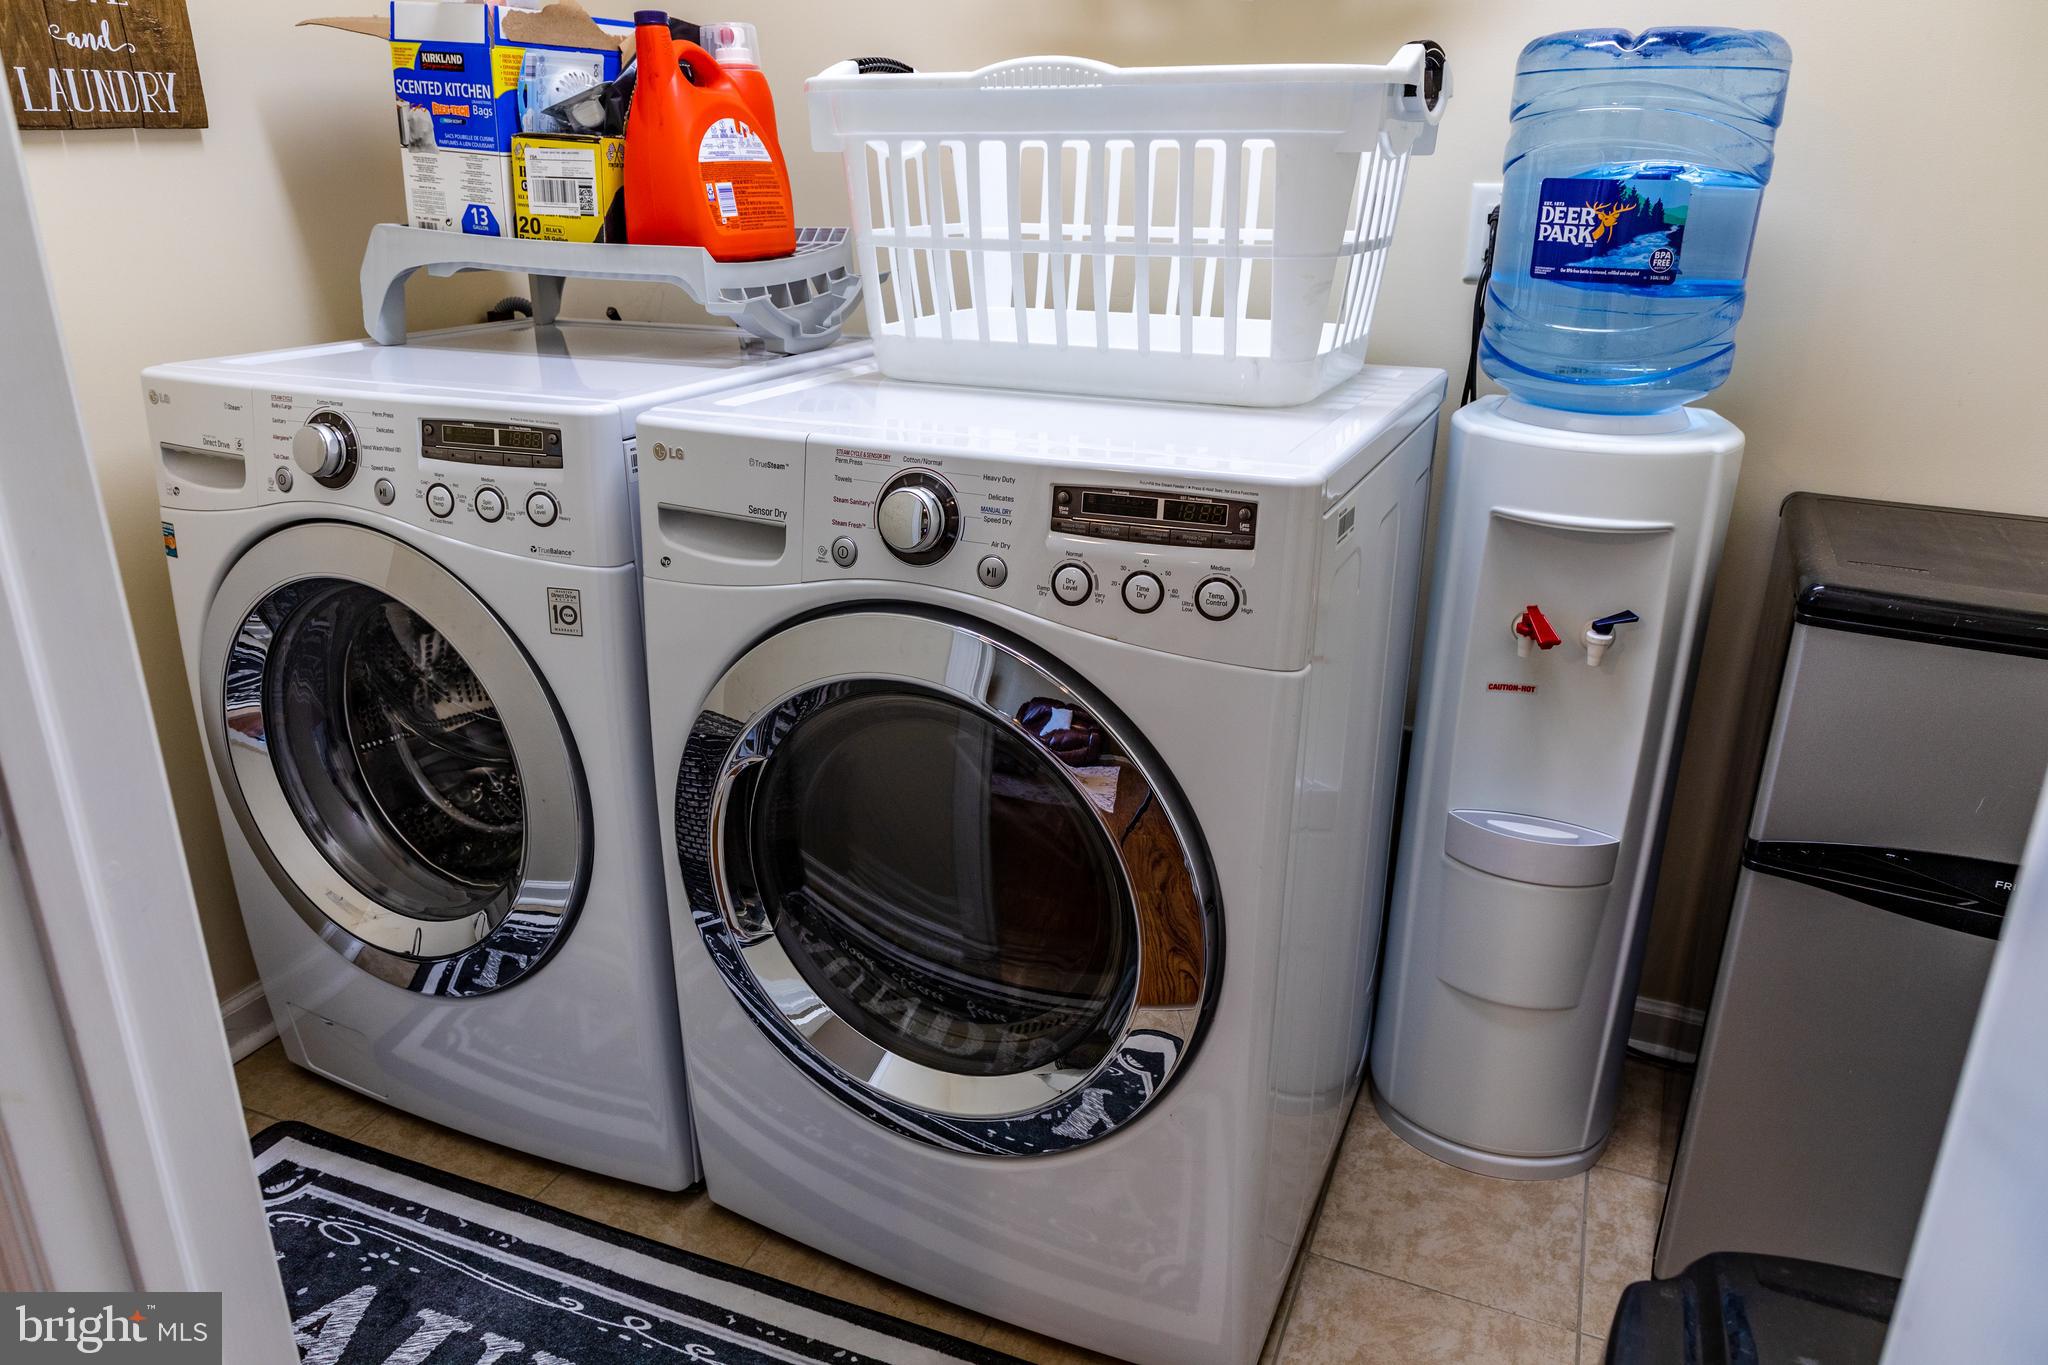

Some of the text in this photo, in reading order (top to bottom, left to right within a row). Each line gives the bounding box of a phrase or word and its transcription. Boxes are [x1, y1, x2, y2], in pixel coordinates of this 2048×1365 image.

[421, 52, 463, 69] KIRKLAND
[13, 66, 179, 114] LAUNDRY
[395, 78, 491, 99] SCENTED KITCHEN
[472, 105, 493, 118] Bags
[471, 207, 489, 226] 13
[1540, 206, 1596, 225] DEER
[519, 216, 541, 235] 20
[1538, 224, 1596, 246] PARK
[1654, 251, 1671, 259] BPA
[1653, 259, 1671, 267] FREE
[202, 437, 230, 449] Direct Drive
[668, 447, 684, 460] LG
[836, 448, 850, 456] STEAM
[866, 451, 882, 459] SENSOR
[902, 455, 943, 466] Cotton/Normal
[834, 474, 853, 483] Towels
[983, 474, 1016, 485] Heavy Duty
[832, 495, 849, 504] Steam
[988, 493, 1015, 502] Delicates
[748, 504, 788, 520] Sensor Dry
[980, 505, 1001, 514] MANUAL
[831, 518, 848, 527] Steam
[983, 515, 1013, 527] Speed Dry
[991, 540, 1011, 550] Air Dry
[1065, 550, 1083, 558] Normal
[1210, 564, 1231, 572] Medium
[1066, 578, 1076, 586] Dry
[1037, 584, 1051, 592] Damp
[1136, 584, 1150, 592] Time
[1136, 591, 1147, 599] Dry
[1205, 598, 1228, 607] Control
[552, 604, 578, 625] 10
[1241, 607, 1254, 615] High
[1488, 683, 1536, 693] CAUTION-HOT
